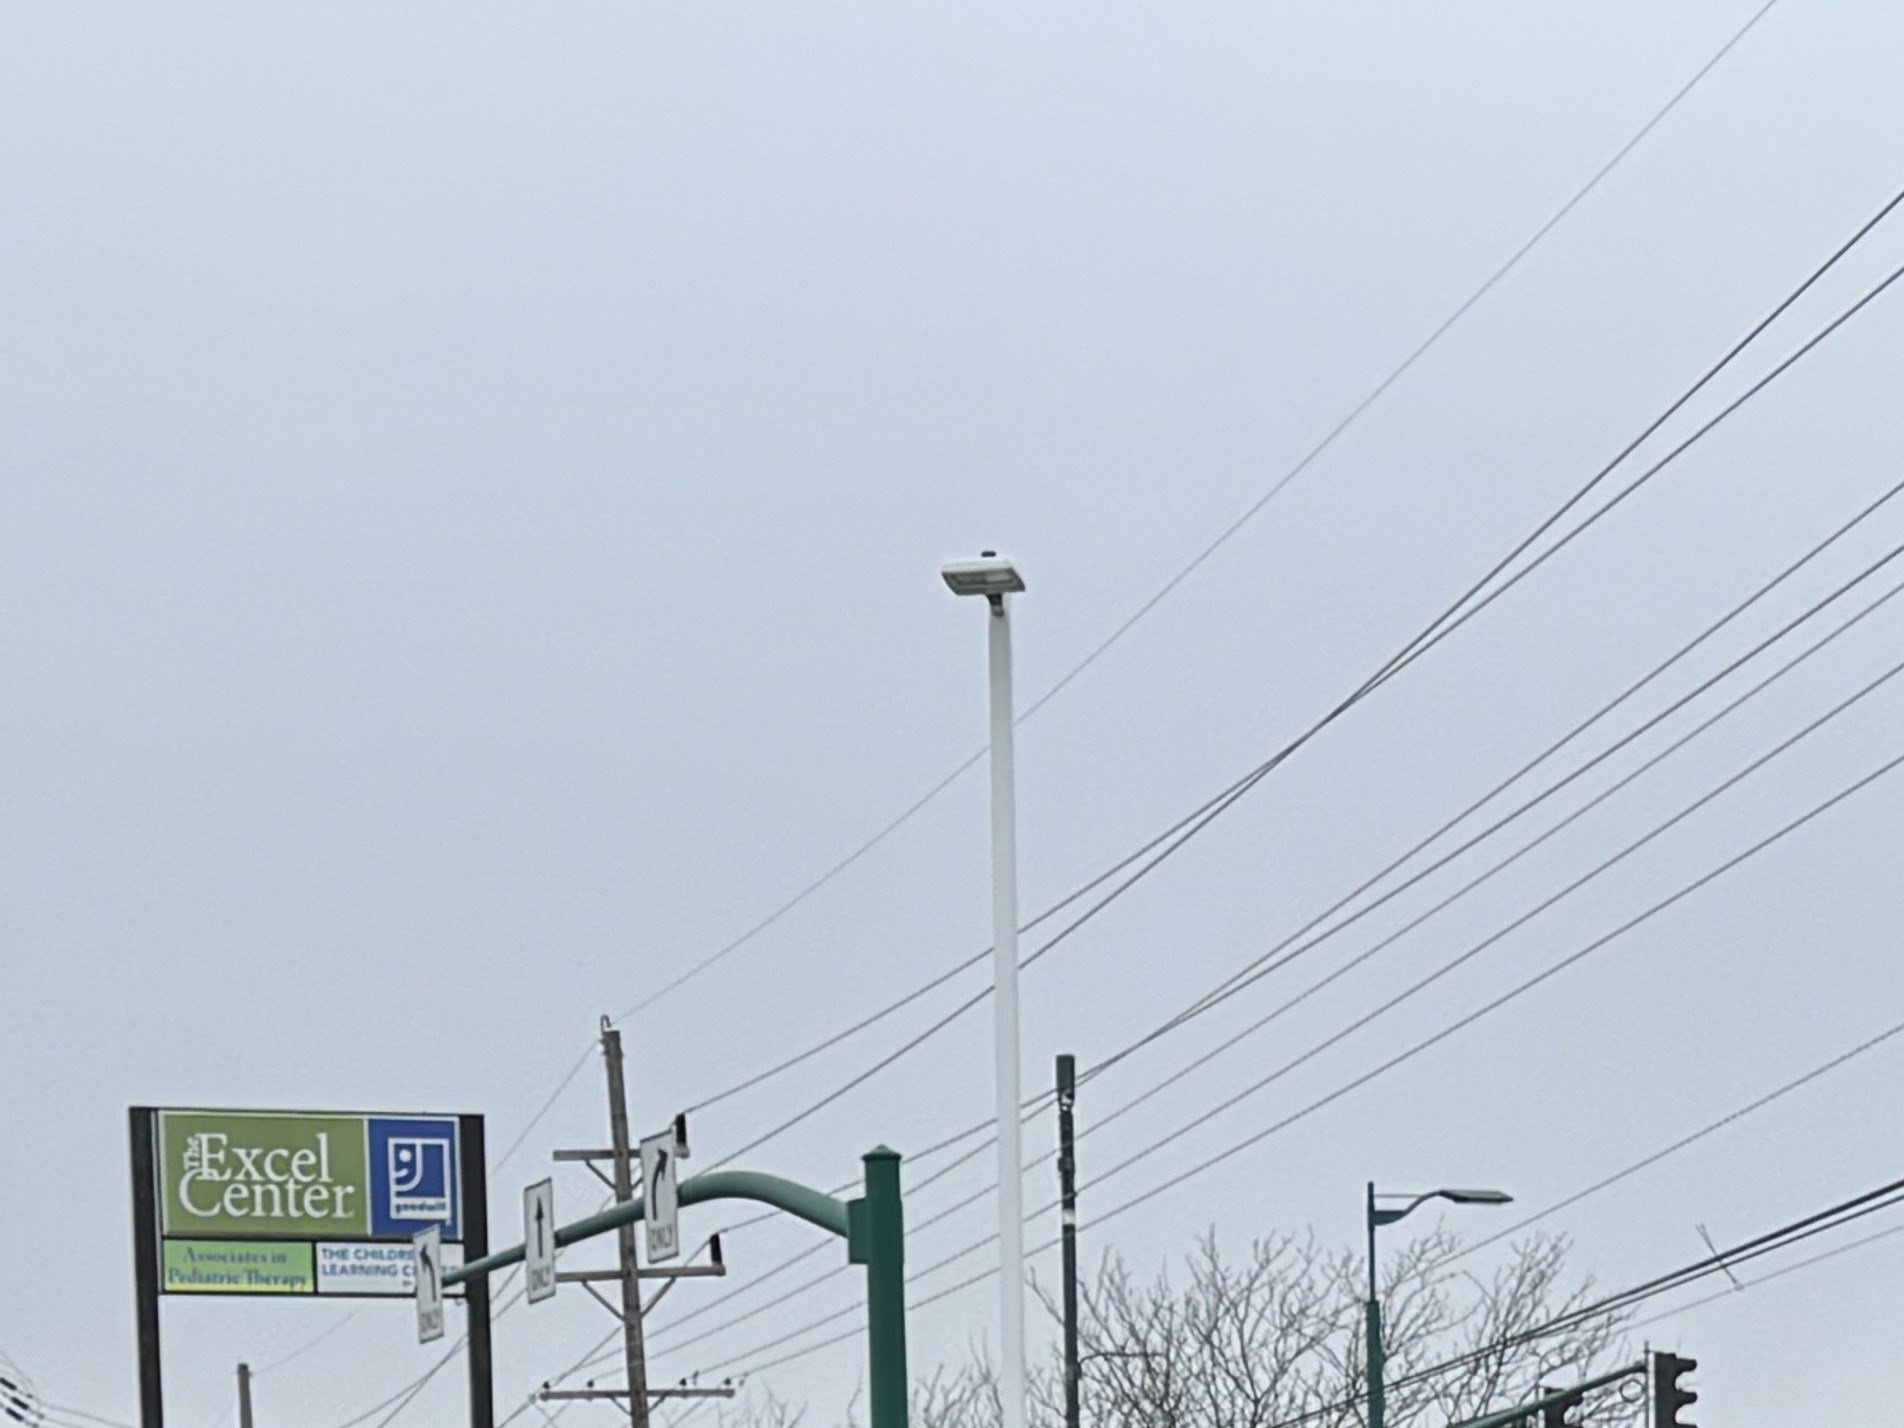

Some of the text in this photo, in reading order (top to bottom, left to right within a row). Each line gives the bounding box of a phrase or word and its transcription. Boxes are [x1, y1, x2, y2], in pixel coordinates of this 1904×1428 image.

[182, 1135, 204, 1170] The
[199, 1132, 333, 1182] Excel
[179, 1167, 355, 1218] Center
[393, 1200, 447, 1214] goodwill
[182, 1247, 288, 1264] Associates in
[321, 1248, 415, 1261] THE CHILDRE
[168, 1267, 307, 1291] Pediatric Therapy
[321, 1263, 398, 1277] LEARNING
